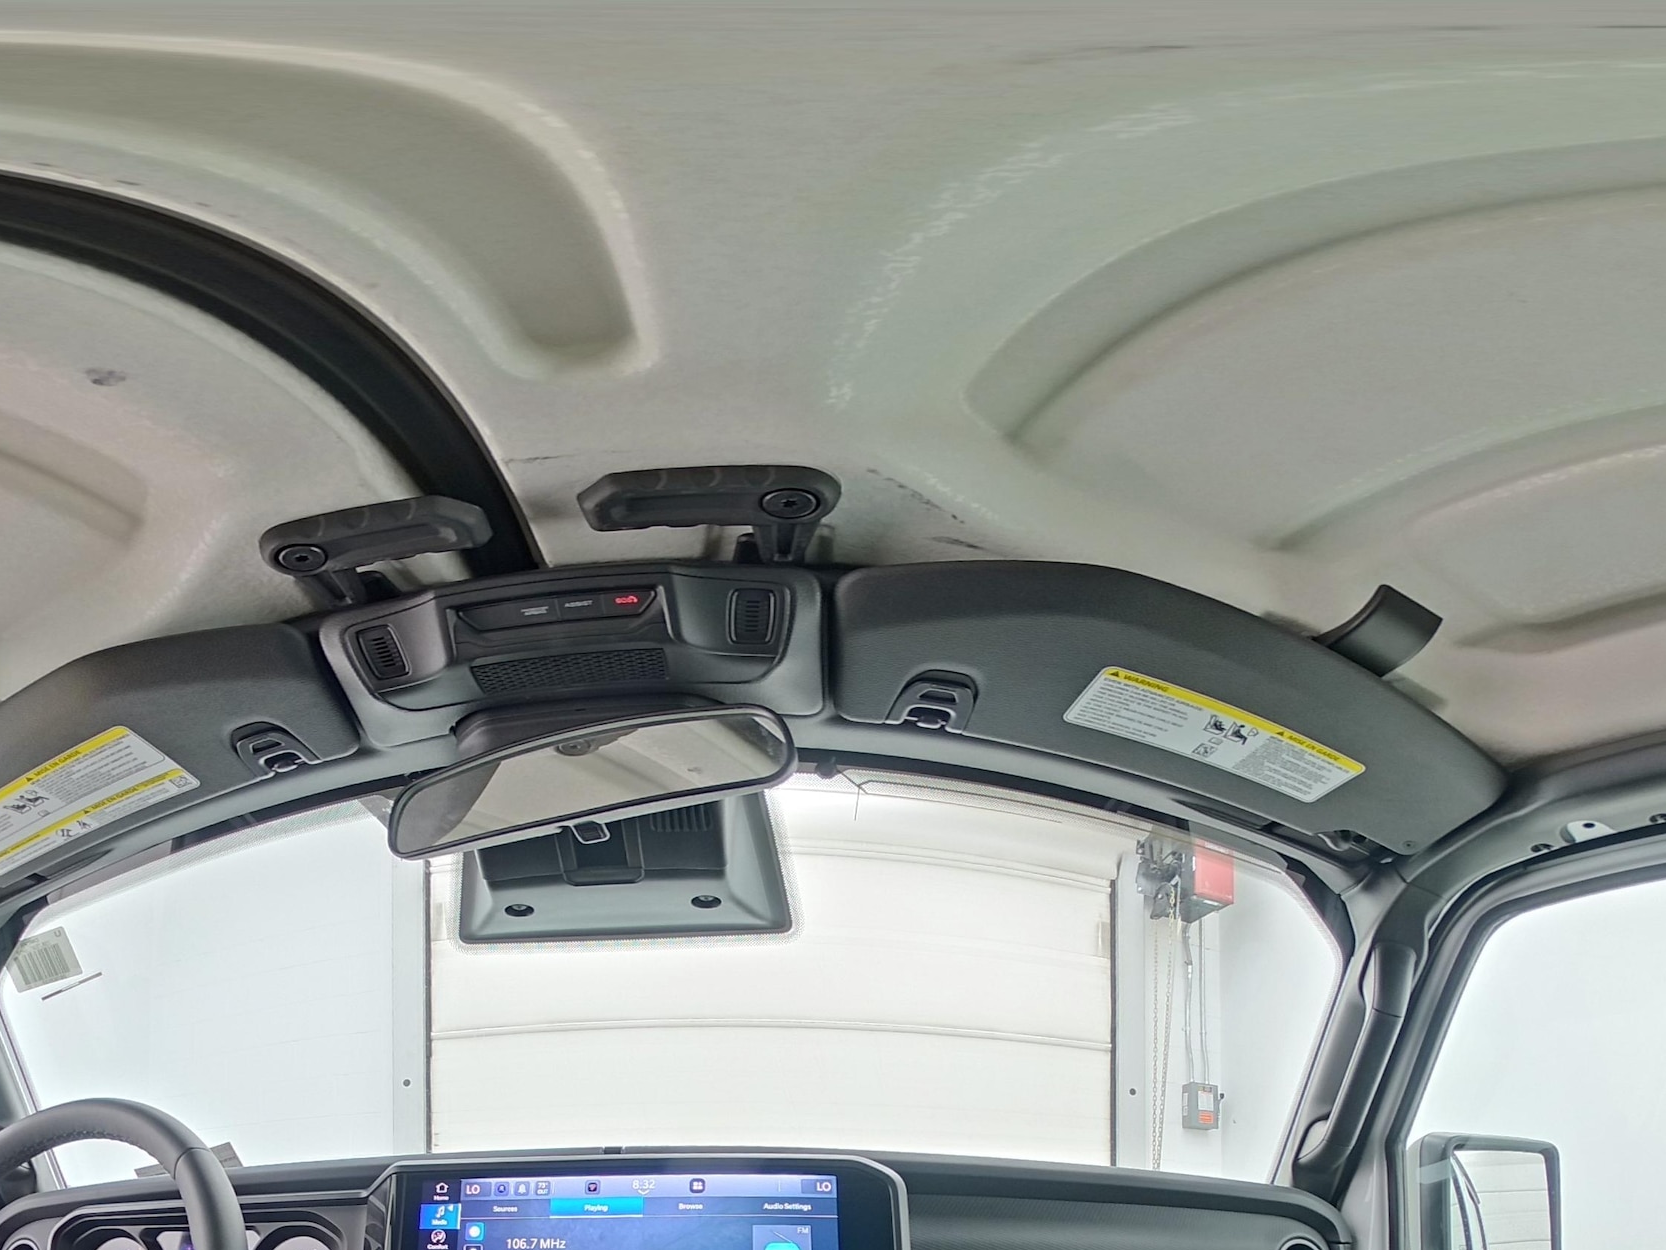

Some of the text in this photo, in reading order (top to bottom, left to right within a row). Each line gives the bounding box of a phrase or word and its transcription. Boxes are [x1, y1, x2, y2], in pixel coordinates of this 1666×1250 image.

[1123, 673, 1170, 693] WARNING
[632, 1179, 656, 1189] 8:32
[816, 1181, 832, 1192] LO
[466, 1184, 481, 1195] LO
[492, 1205, 518, 1213] Sources
[583, 1204, 609, 1213] Playing
[763, 1202, 812, 1212] Audio Settings
[796, 1226, 809, 1234] FM
[506, 1237, 567, 1250] 106.7 MHz
